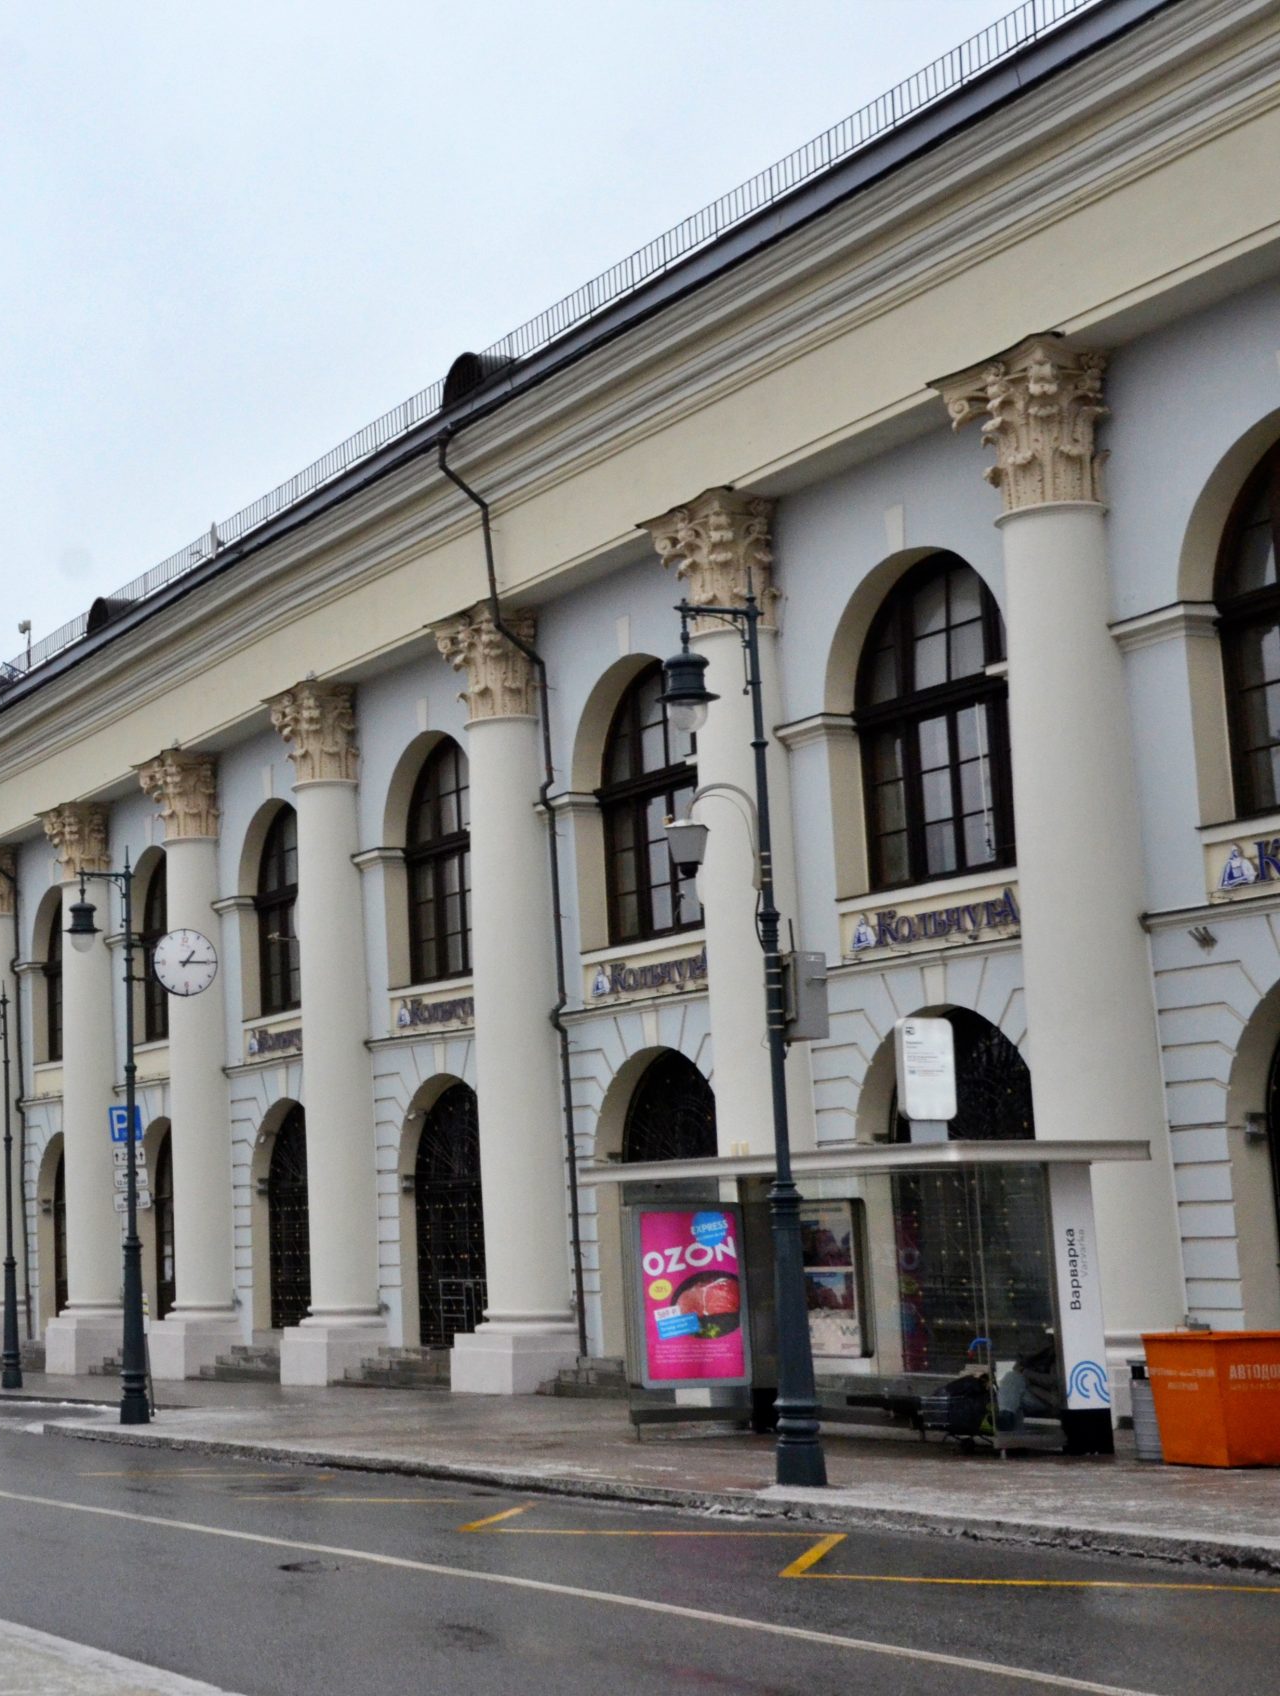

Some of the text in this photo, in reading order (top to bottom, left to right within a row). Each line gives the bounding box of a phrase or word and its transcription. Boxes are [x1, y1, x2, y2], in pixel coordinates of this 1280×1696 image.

[691, 1219, 728, 1235] EXPRESS
[643, 1236, 737, 1276] OZON
[1065, 1228, 1082, 1311] Варварка
